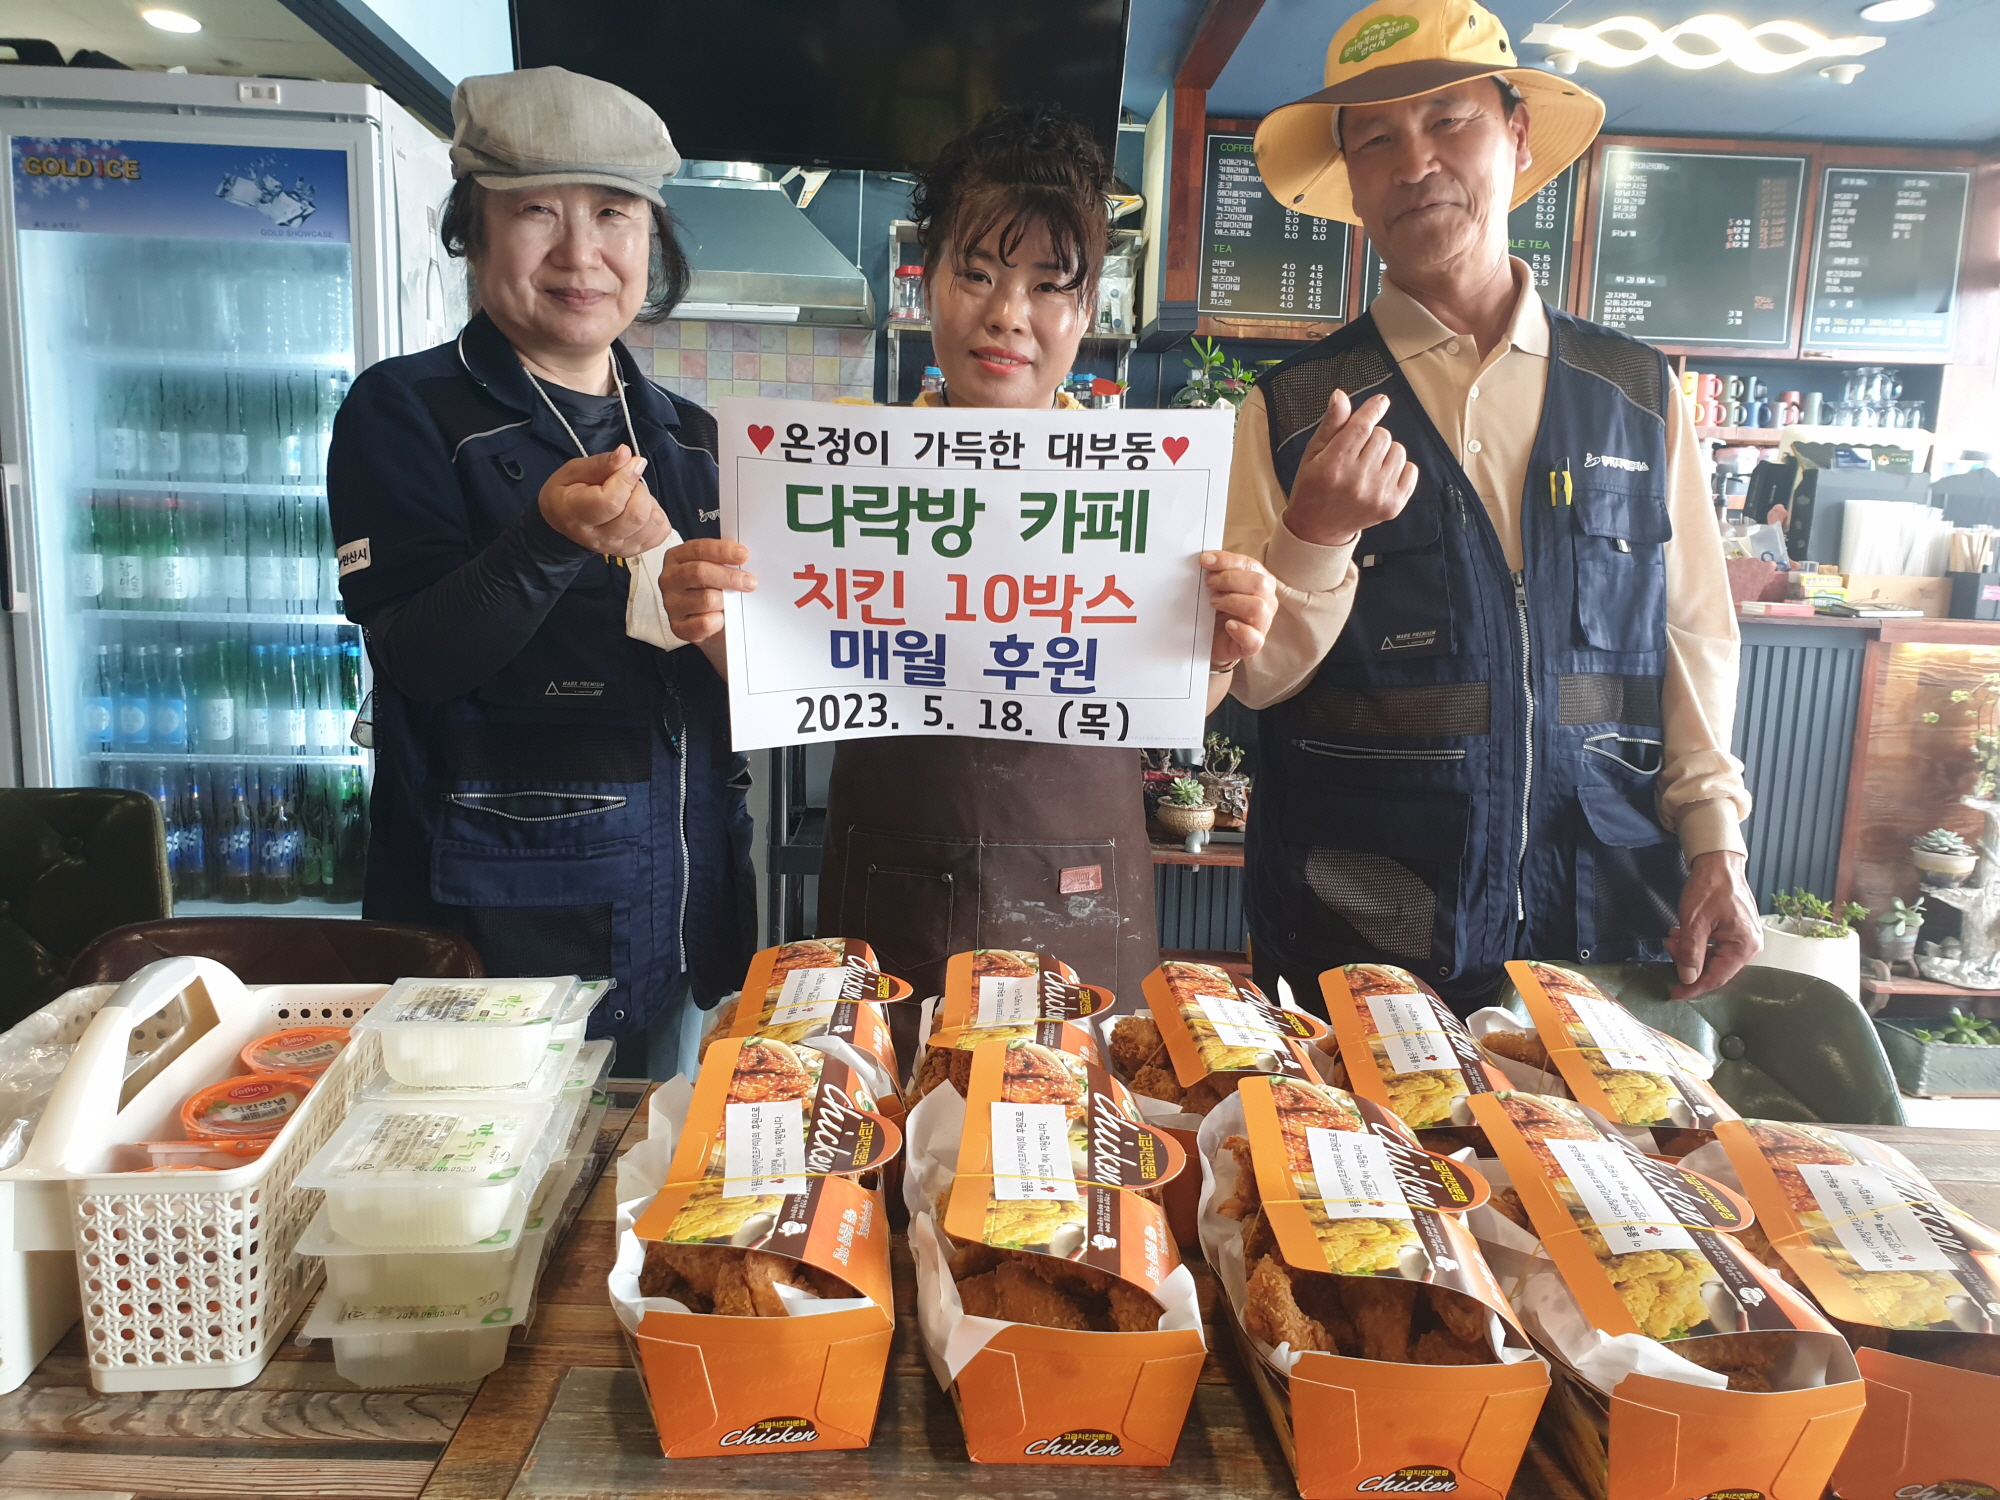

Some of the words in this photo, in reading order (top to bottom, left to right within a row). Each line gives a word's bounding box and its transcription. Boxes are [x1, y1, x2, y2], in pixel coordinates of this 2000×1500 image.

[24, 156, 94, 178] GOLD
[96, 159, 140, 180] ICE
[1218, 174, 1262, 182] 카라멜마끼아
[1536, 205, 1556, 213] 5.0
[1536, 213, 1555, 221] 5.0
[261, 228, 284, 237] GOLD
[286, 230, 334, 239] SHOWCASE
[1535, 221, 1554, 229] 5.0
[1312, 233, 1326, 241] 6.0
[1529, 240, 1550, 249] TEA
[1213, 244, 1232, 253] TEA
[1533, 254, 1551, 262] 5.5
[1310, 264, 1324, 272] 4.5
[1532, 262, 1550, 270] 5.5
[1280, 286, 1294, 294] 4.0
[780, 423, 889, 466] 온정이
[914, 429, 1026, 471] 가득한
[1048, 432, 1156, 471] 대부동
[785, 483, 985, 559] 다락방
[1019, 489, 1150, 555] 카페
[342, 548, 366, 567] 안산시
[793, 563, 905, 626] 치킨
[944, 573, 1137, 634] 10박스
[1411, 629, 1437, 637] PREMIUM
[830, 629, 946, 688] 매월
[983, 633, 1098, 694] 후원
[796, 693, 900, 735] 2023.
[922, 695, 955, 730] 5.
[978, 699, 1033, 736] 18.
[1057, 700, 1130, 742] (목)
[285, 1043, 334, 1058] 치킨양념
[231, 1097, 287, 1113] 치킨양념
[808, 1083, 863, 1175] Chicken
[1015, 1111, 1027, 1134] 후원으로
[852, 1121, 875, 1166] 고급치킨전문점
[1038, 1121, 1050, 1152] 지원합니다.
[1093, 1091, 1140, 1187] Chicken
[1137, 1132, 1157, 1179] 고급치킨전문점
[1371, 1122, 1444, 1208] Chicken
[1038, 1164, 1050, 1185] 사의열매
[1430, 1159, 1468, 1203] 고급치킨전문점
[1678, 1171, 1738, 1221] 고급치킨전문점
[757, 1419, 807, 1429] 고급치킨전문점
[720, 1426, 819, 1447] Chicken
[1025, 1437, 1123, 1456] Chicken
[1357, 1473, 1458, 1492] Chicken
